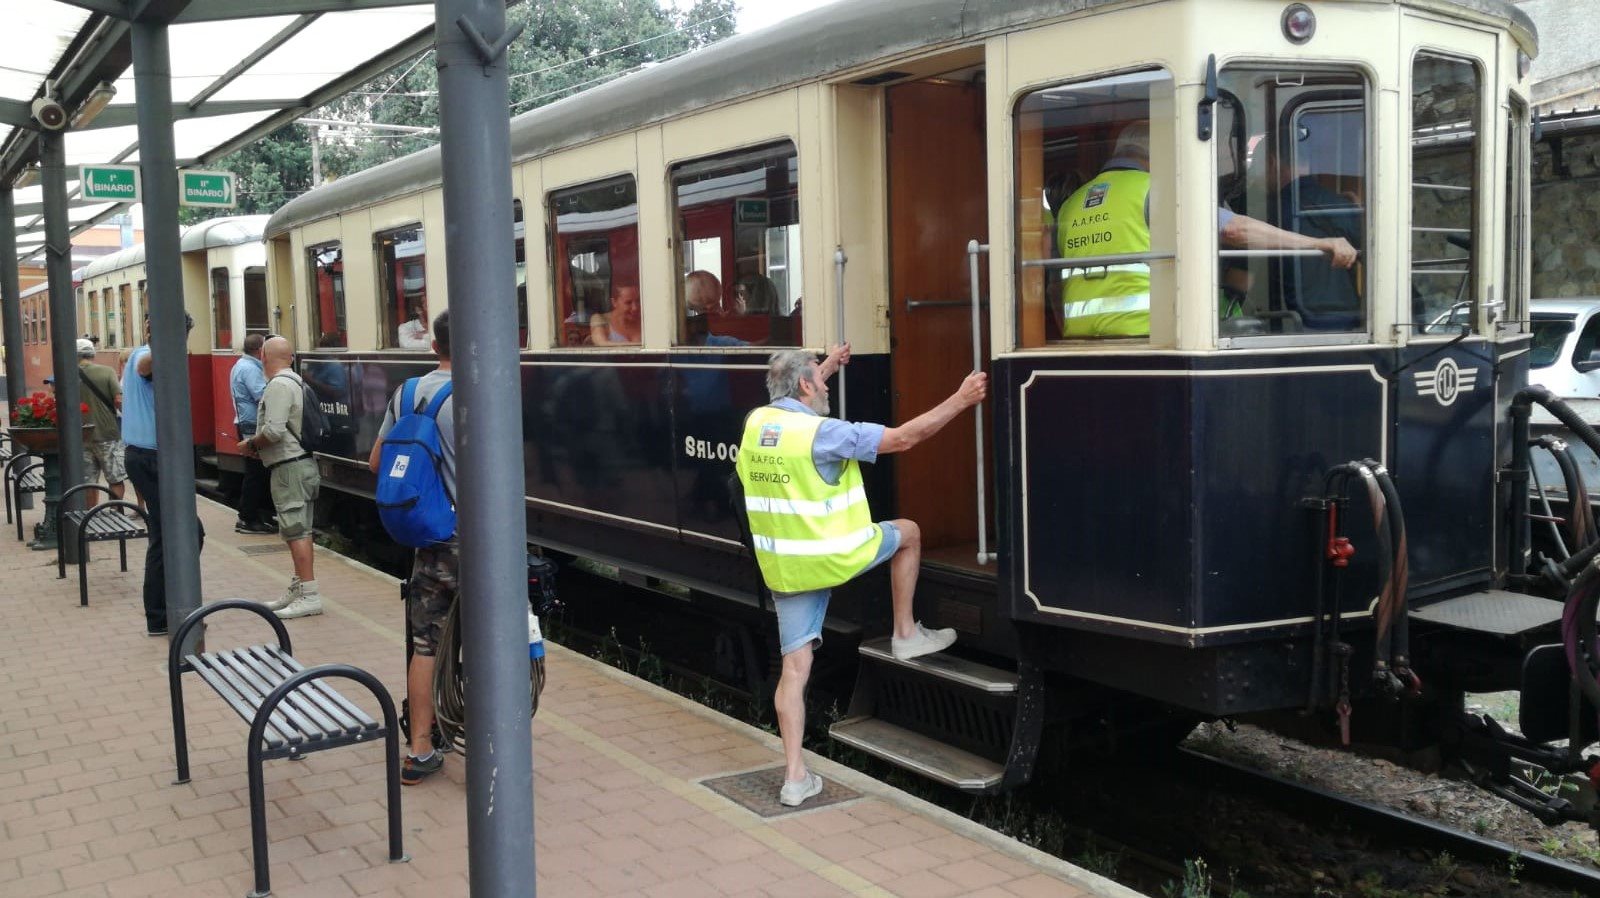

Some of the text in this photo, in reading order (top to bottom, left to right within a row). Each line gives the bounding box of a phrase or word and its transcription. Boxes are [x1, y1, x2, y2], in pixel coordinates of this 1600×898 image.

[94, 183, 134, 192] BINARIO
[186, 188, 224, 198] BINARIO
[319, 401, 335, 414] OZZA
[685, 435, 739, 463] SALOO
[749, 471, 790, 483] SERVIZIO
